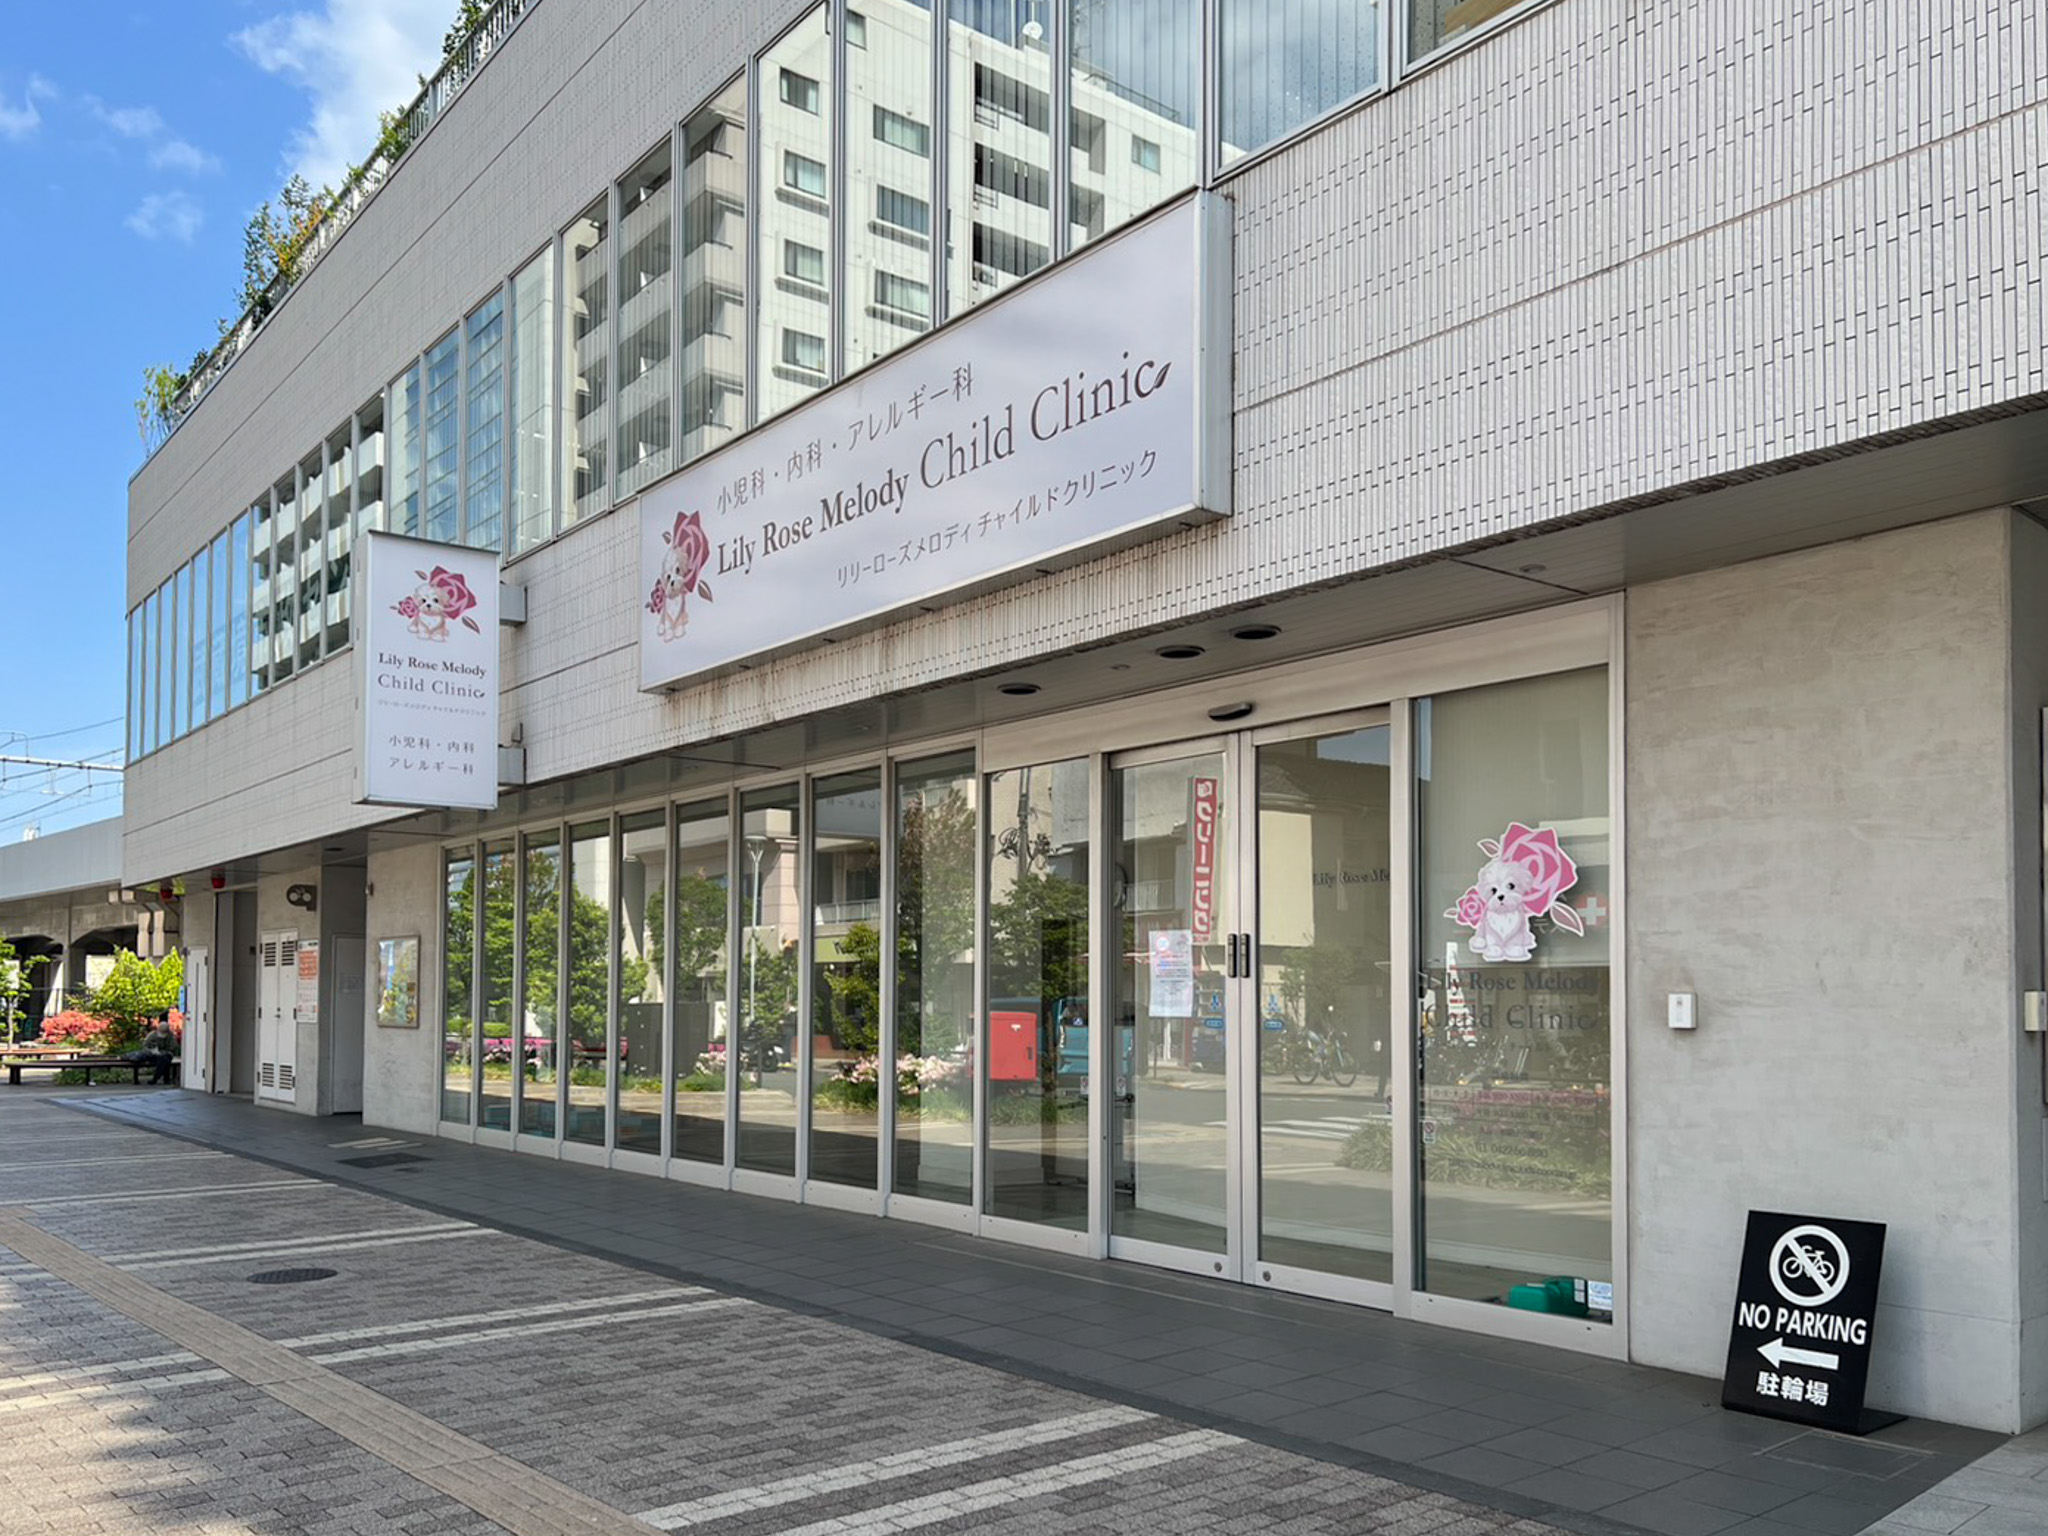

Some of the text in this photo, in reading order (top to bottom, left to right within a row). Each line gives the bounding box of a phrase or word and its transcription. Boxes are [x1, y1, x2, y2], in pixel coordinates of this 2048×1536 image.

[717, 362, 973, 515] 小児科・内科・アレルギー科
[717, 351, 1157, 575] Lily Rose Melody Child Clinic
[379, 652, 487, 679] Lily Rose Melody
[377, 673, 483, 698] Child Clinic
[389, 735, 475, 754] 小児科・内科
[389, 757, 474, 775] アレルギー科
[1427, 972, 1599, 996] Lily Rose Melody
[1425, 1004, 1595, 1031] Child Clinic
[1738, 1302, 1867, 1345] NO PARKING
[1756, 1371, 1829, 1406] 駐輪場
